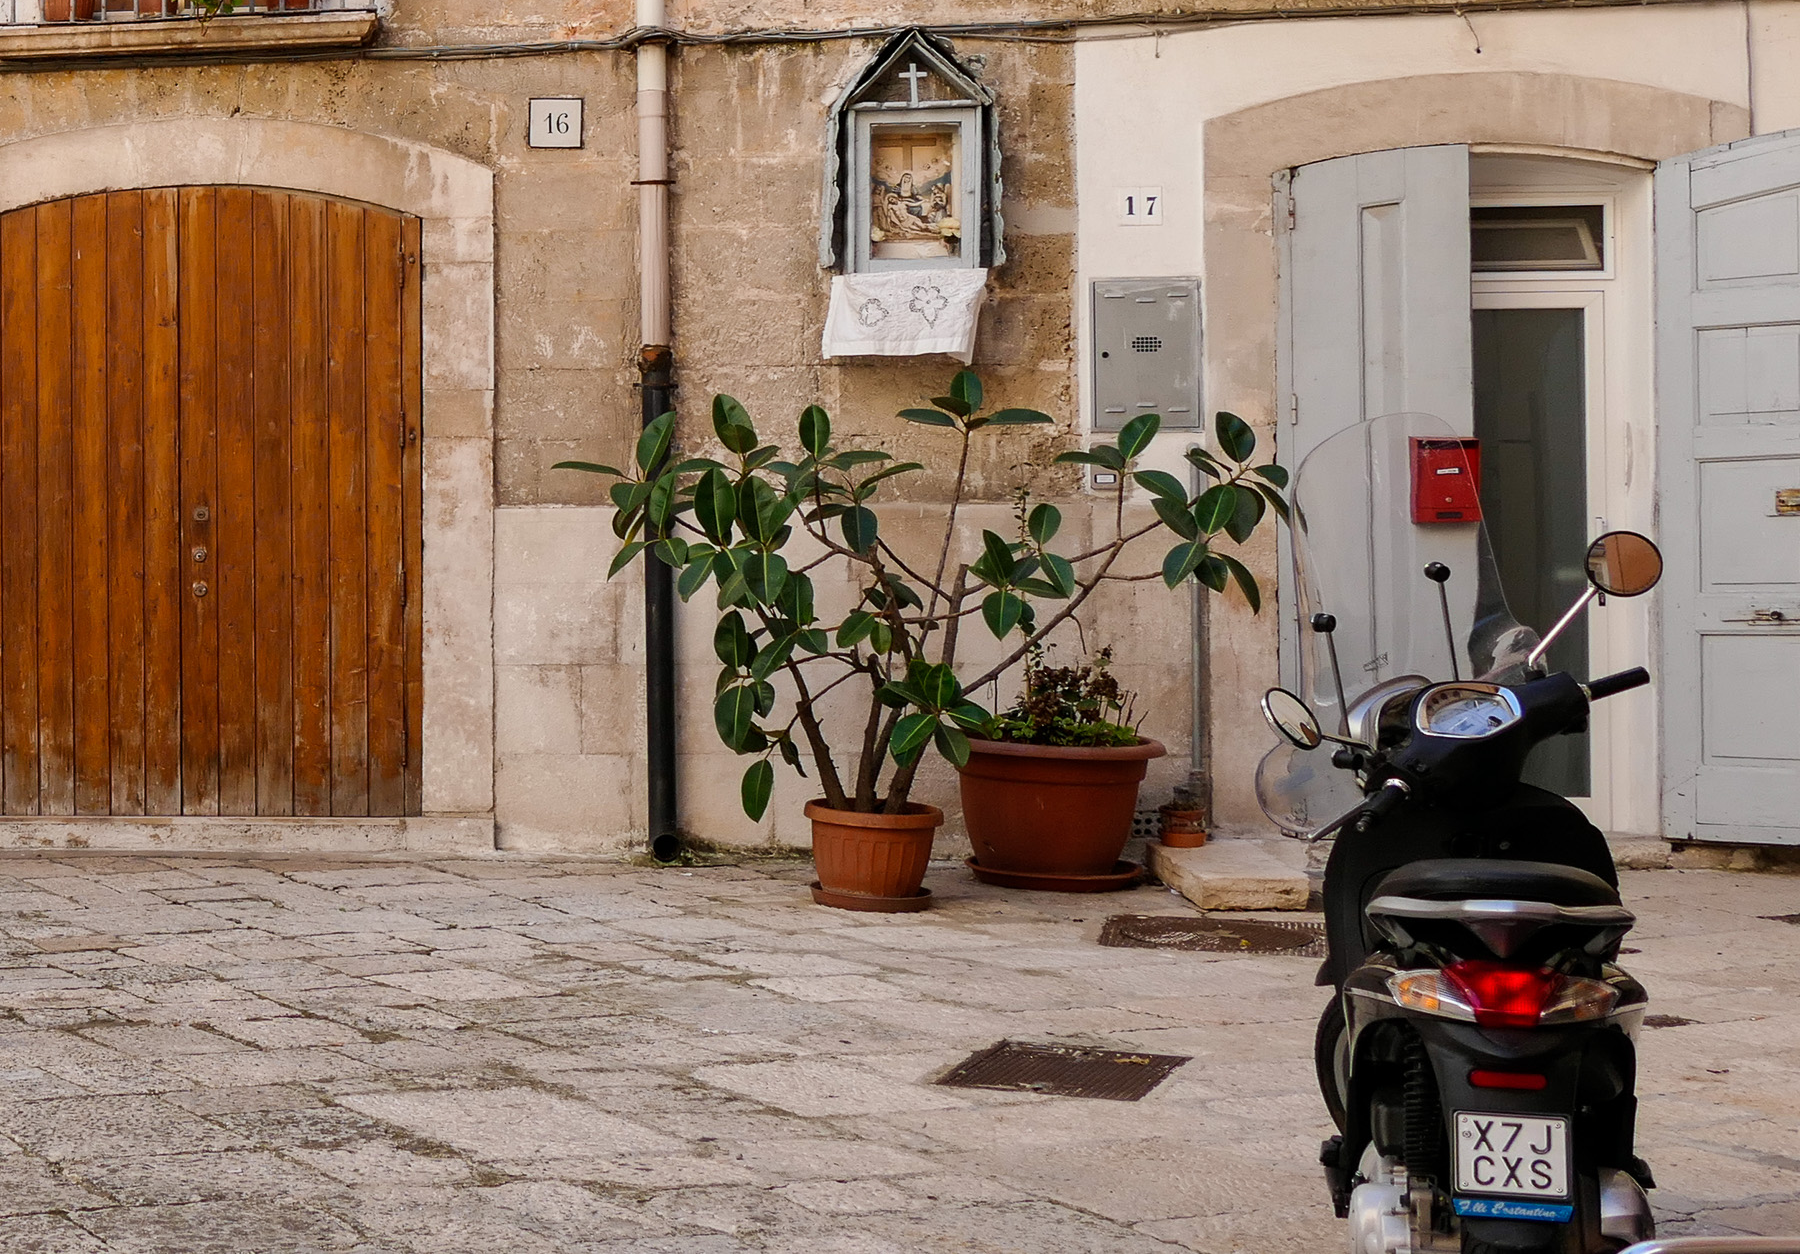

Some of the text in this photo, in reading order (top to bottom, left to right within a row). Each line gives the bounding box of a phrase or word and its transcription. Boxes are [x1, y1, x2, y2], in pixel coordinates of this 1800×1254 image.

[543, 112, 569, 134] 16
[1125, 196, 1158, 215] 17
[1473, 1120, 1552, 1155] X7J
[1473, 1155, 1552, 1190] CXS
